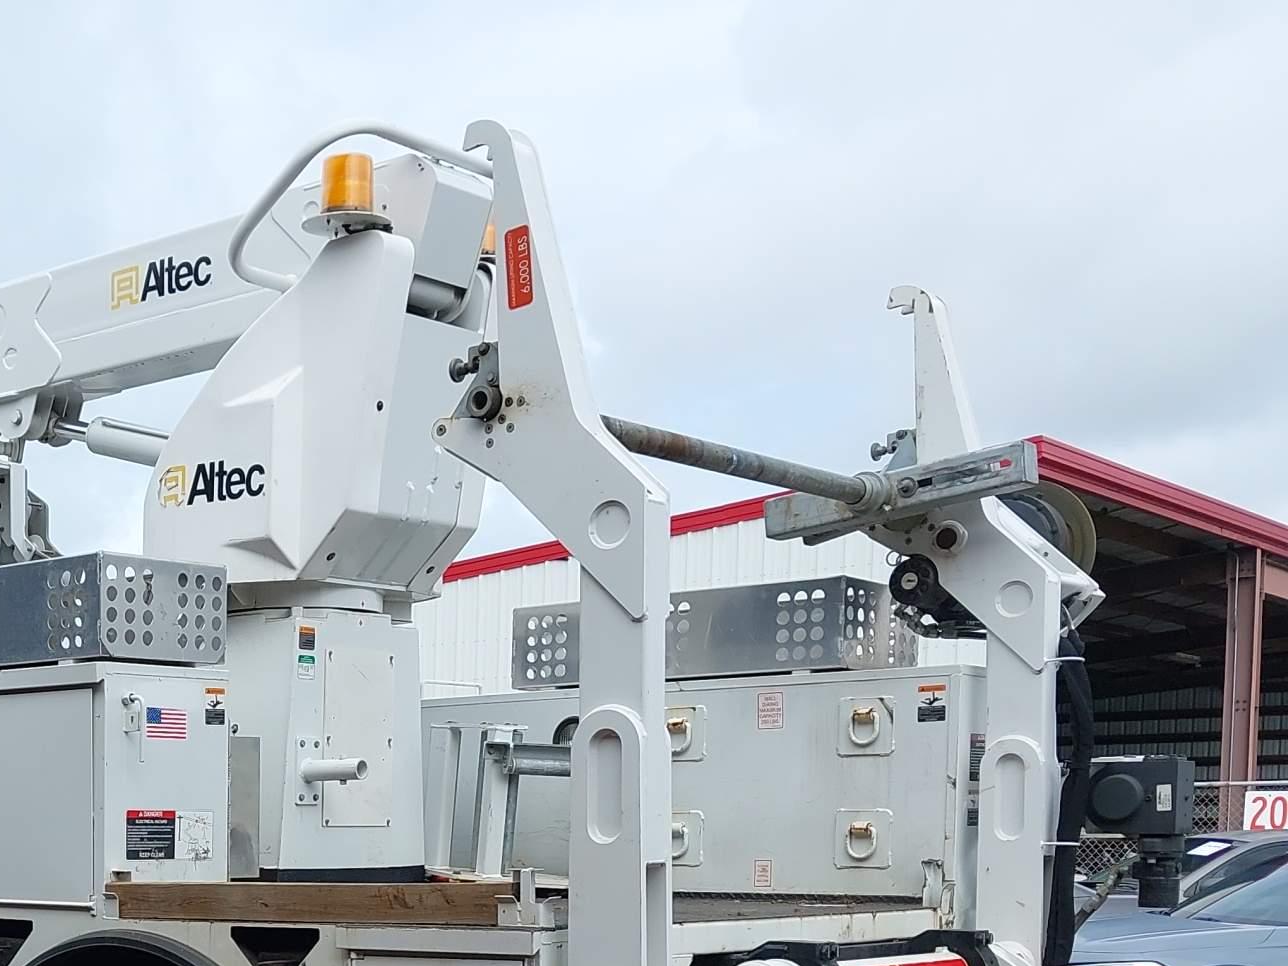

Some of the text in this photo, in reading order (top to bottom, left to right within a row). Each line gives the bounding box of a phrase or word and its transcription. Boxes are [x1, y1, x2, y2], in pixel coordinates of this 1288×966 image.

[517, 235, 528, 257] LBS
[141, 256, 211, 302] Altec
[187, 460, 265, 506] Altec
